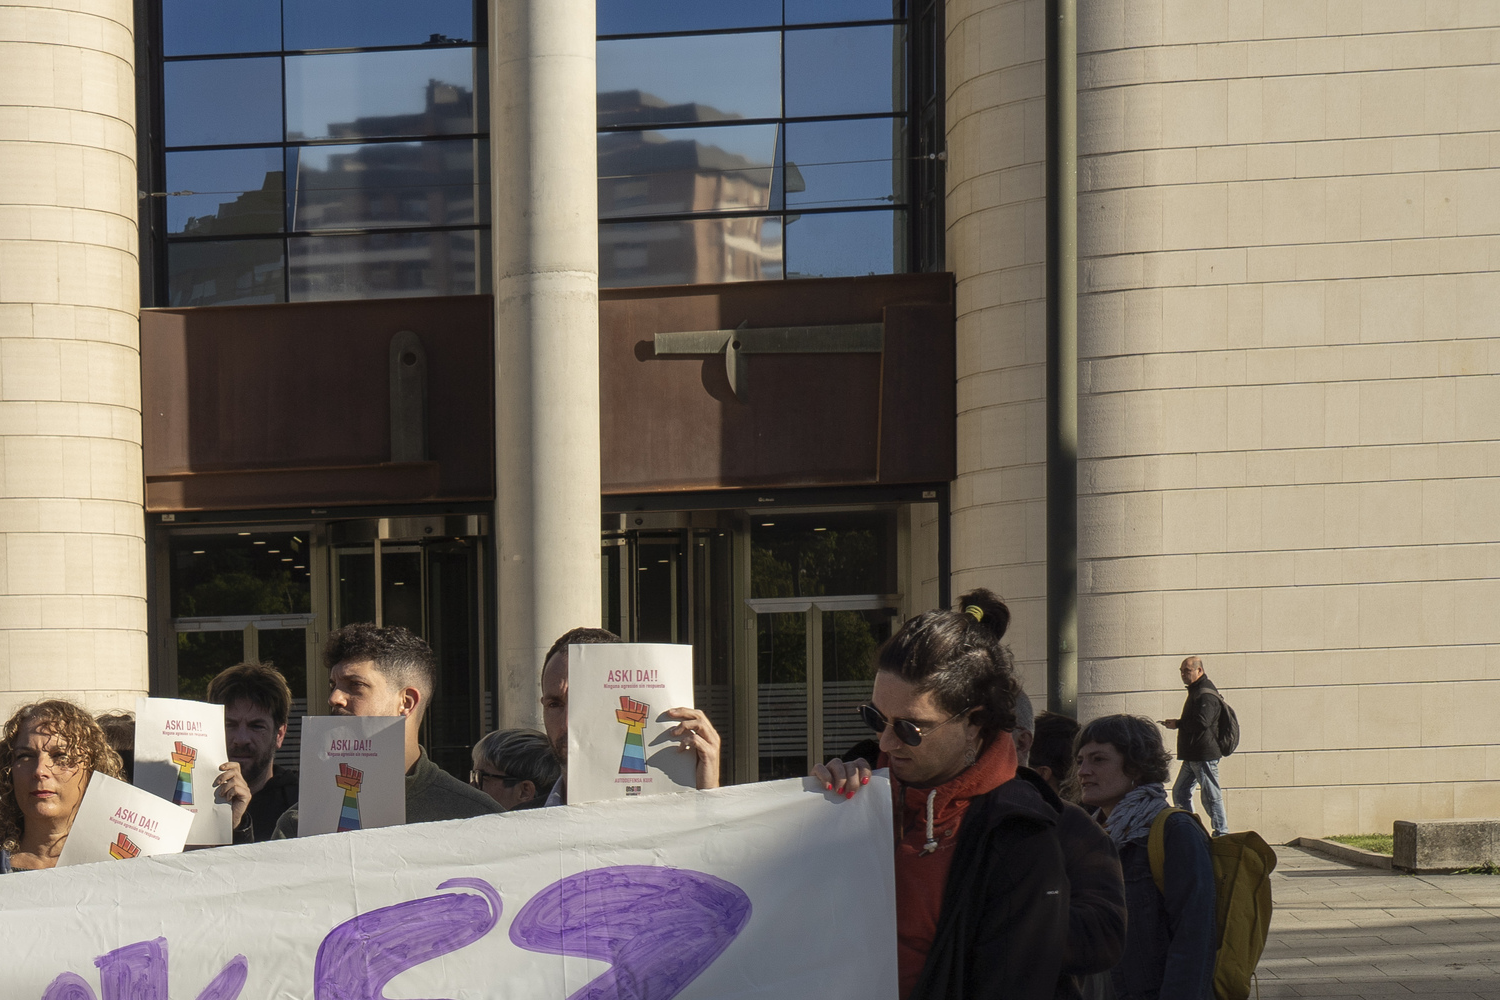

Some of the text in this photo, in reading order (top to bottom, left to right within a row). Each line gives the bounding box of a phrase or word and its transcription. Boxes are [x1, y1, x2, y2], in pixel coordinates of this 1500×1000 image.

[607, 669, 658, 682] ASKI DA!!
[165, 719, 203, 732] ASKI DA!!
[330, 739, 372, 751] ASKI DA!!
[114, 806, 159, 833] ASKI DA!!
